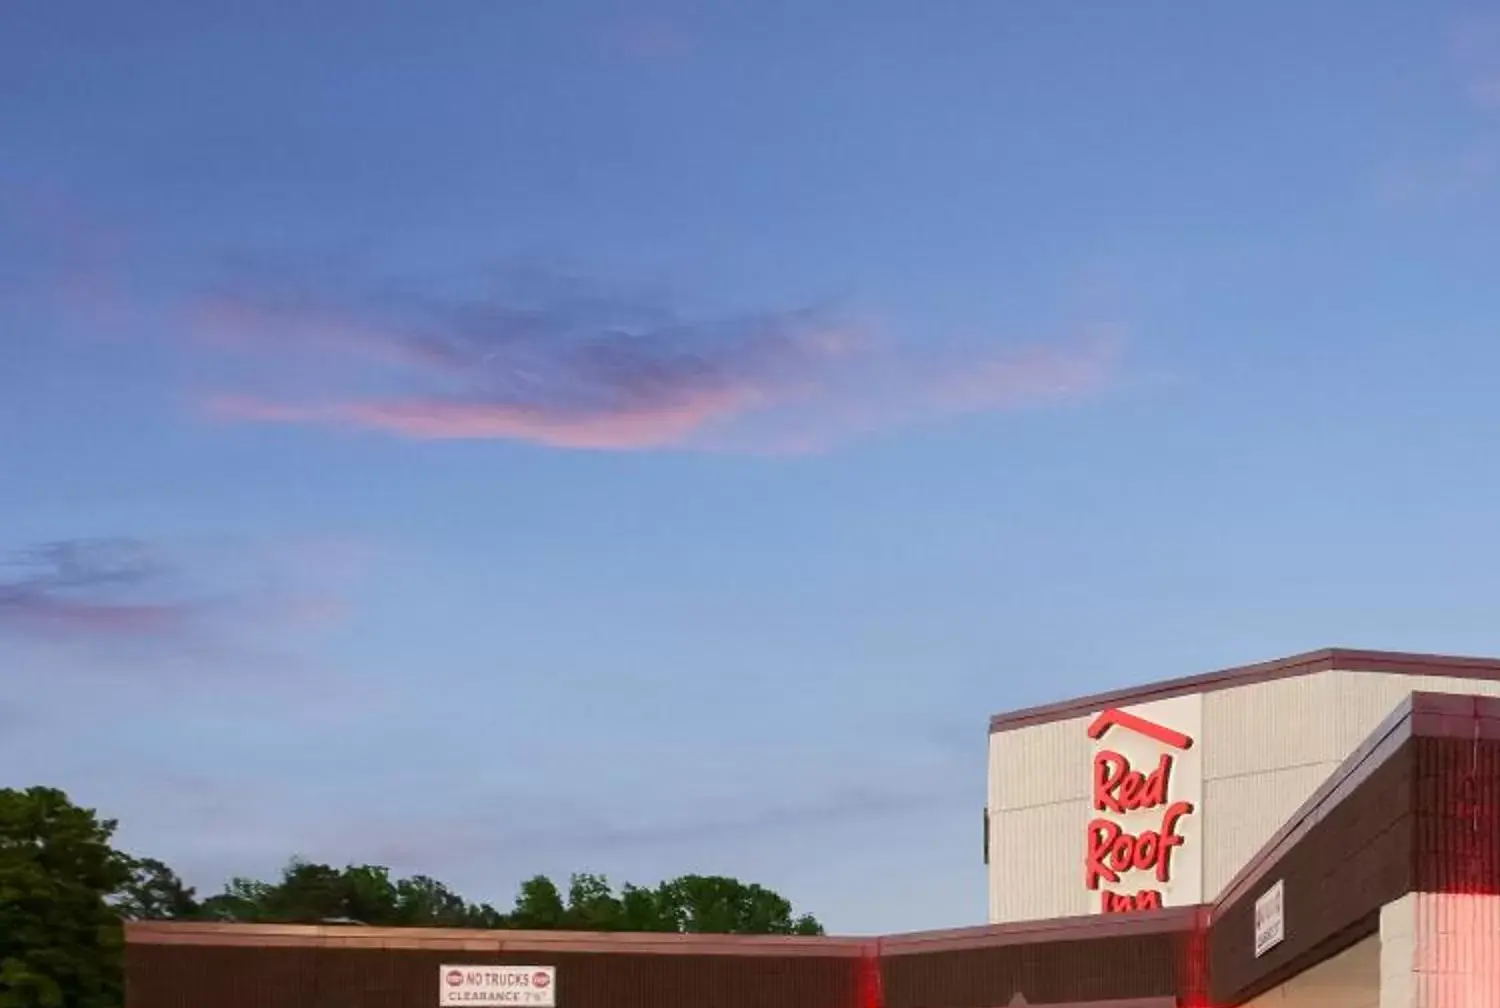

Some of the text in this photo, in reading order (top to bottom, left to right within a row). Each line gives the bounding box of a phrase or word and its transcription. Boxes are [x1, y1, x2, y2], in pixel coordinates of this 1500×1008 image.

[1093, 750, 1172, 814] Red
[1086, 801, 1194, 890] Roof
[448, 991, 520, 1001] CLEARANCE
[466, 972, 529, 987] NO TRUCKS
